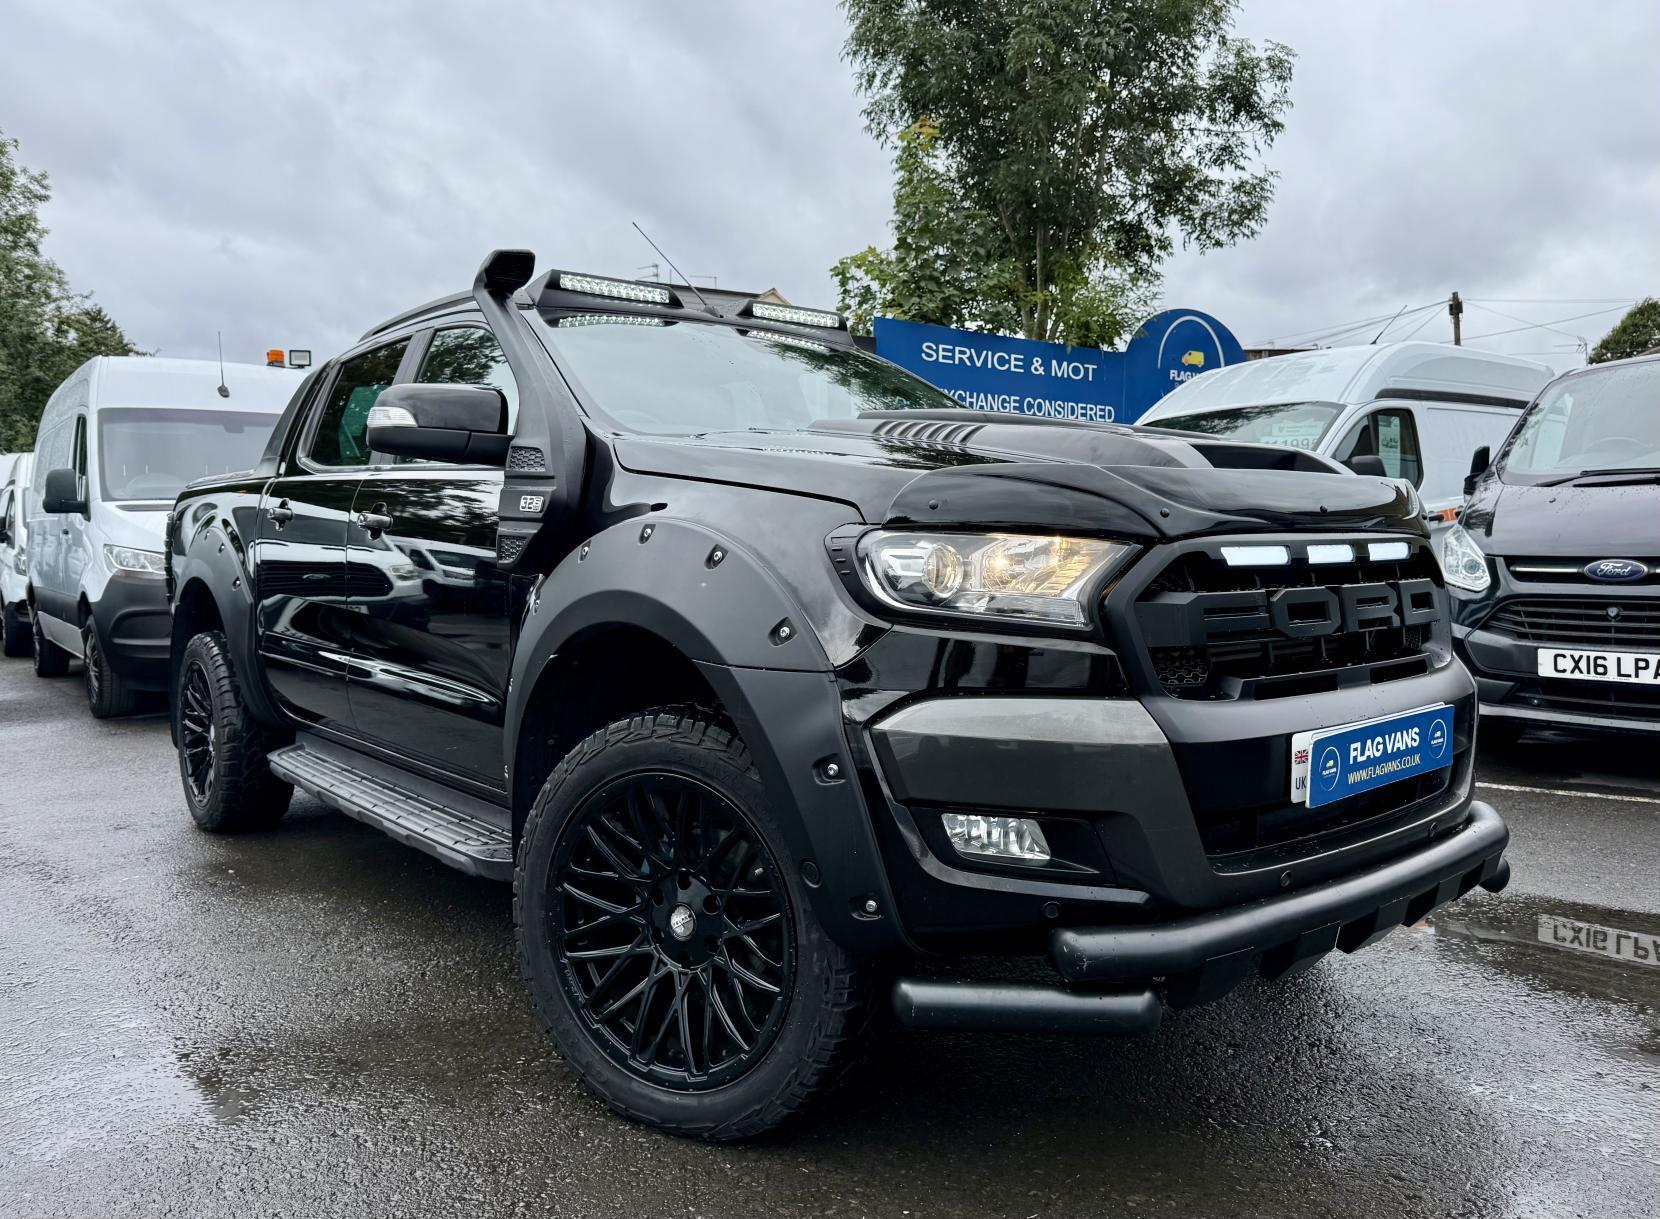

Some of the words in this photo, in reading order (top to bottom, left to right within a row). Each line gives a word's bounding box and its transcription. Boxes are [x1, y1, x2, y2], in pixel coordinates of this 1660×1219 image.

[921, 342, 1025, 373] SERVICE
[1030, 356, 1045, 376] &
[1051, 359, 1098, 382] MOT
[939, 388, 1020, 414] XCHANGE
[1023, 397, 1115, 423] CONSIDERED
[1596, 562, 1633, 577] Ford
[1186, 577, 1444, 647] FORD
[1553, 653, 1608, 676] CX16
[1349, 736, 1384, 765] FLAG
[1384, 726, 1421, 753] VANS
[1295, 775, 1307, 790] UK
[1347, 753, 1421, 785] WWW.FLAGVANS.CO.UK
